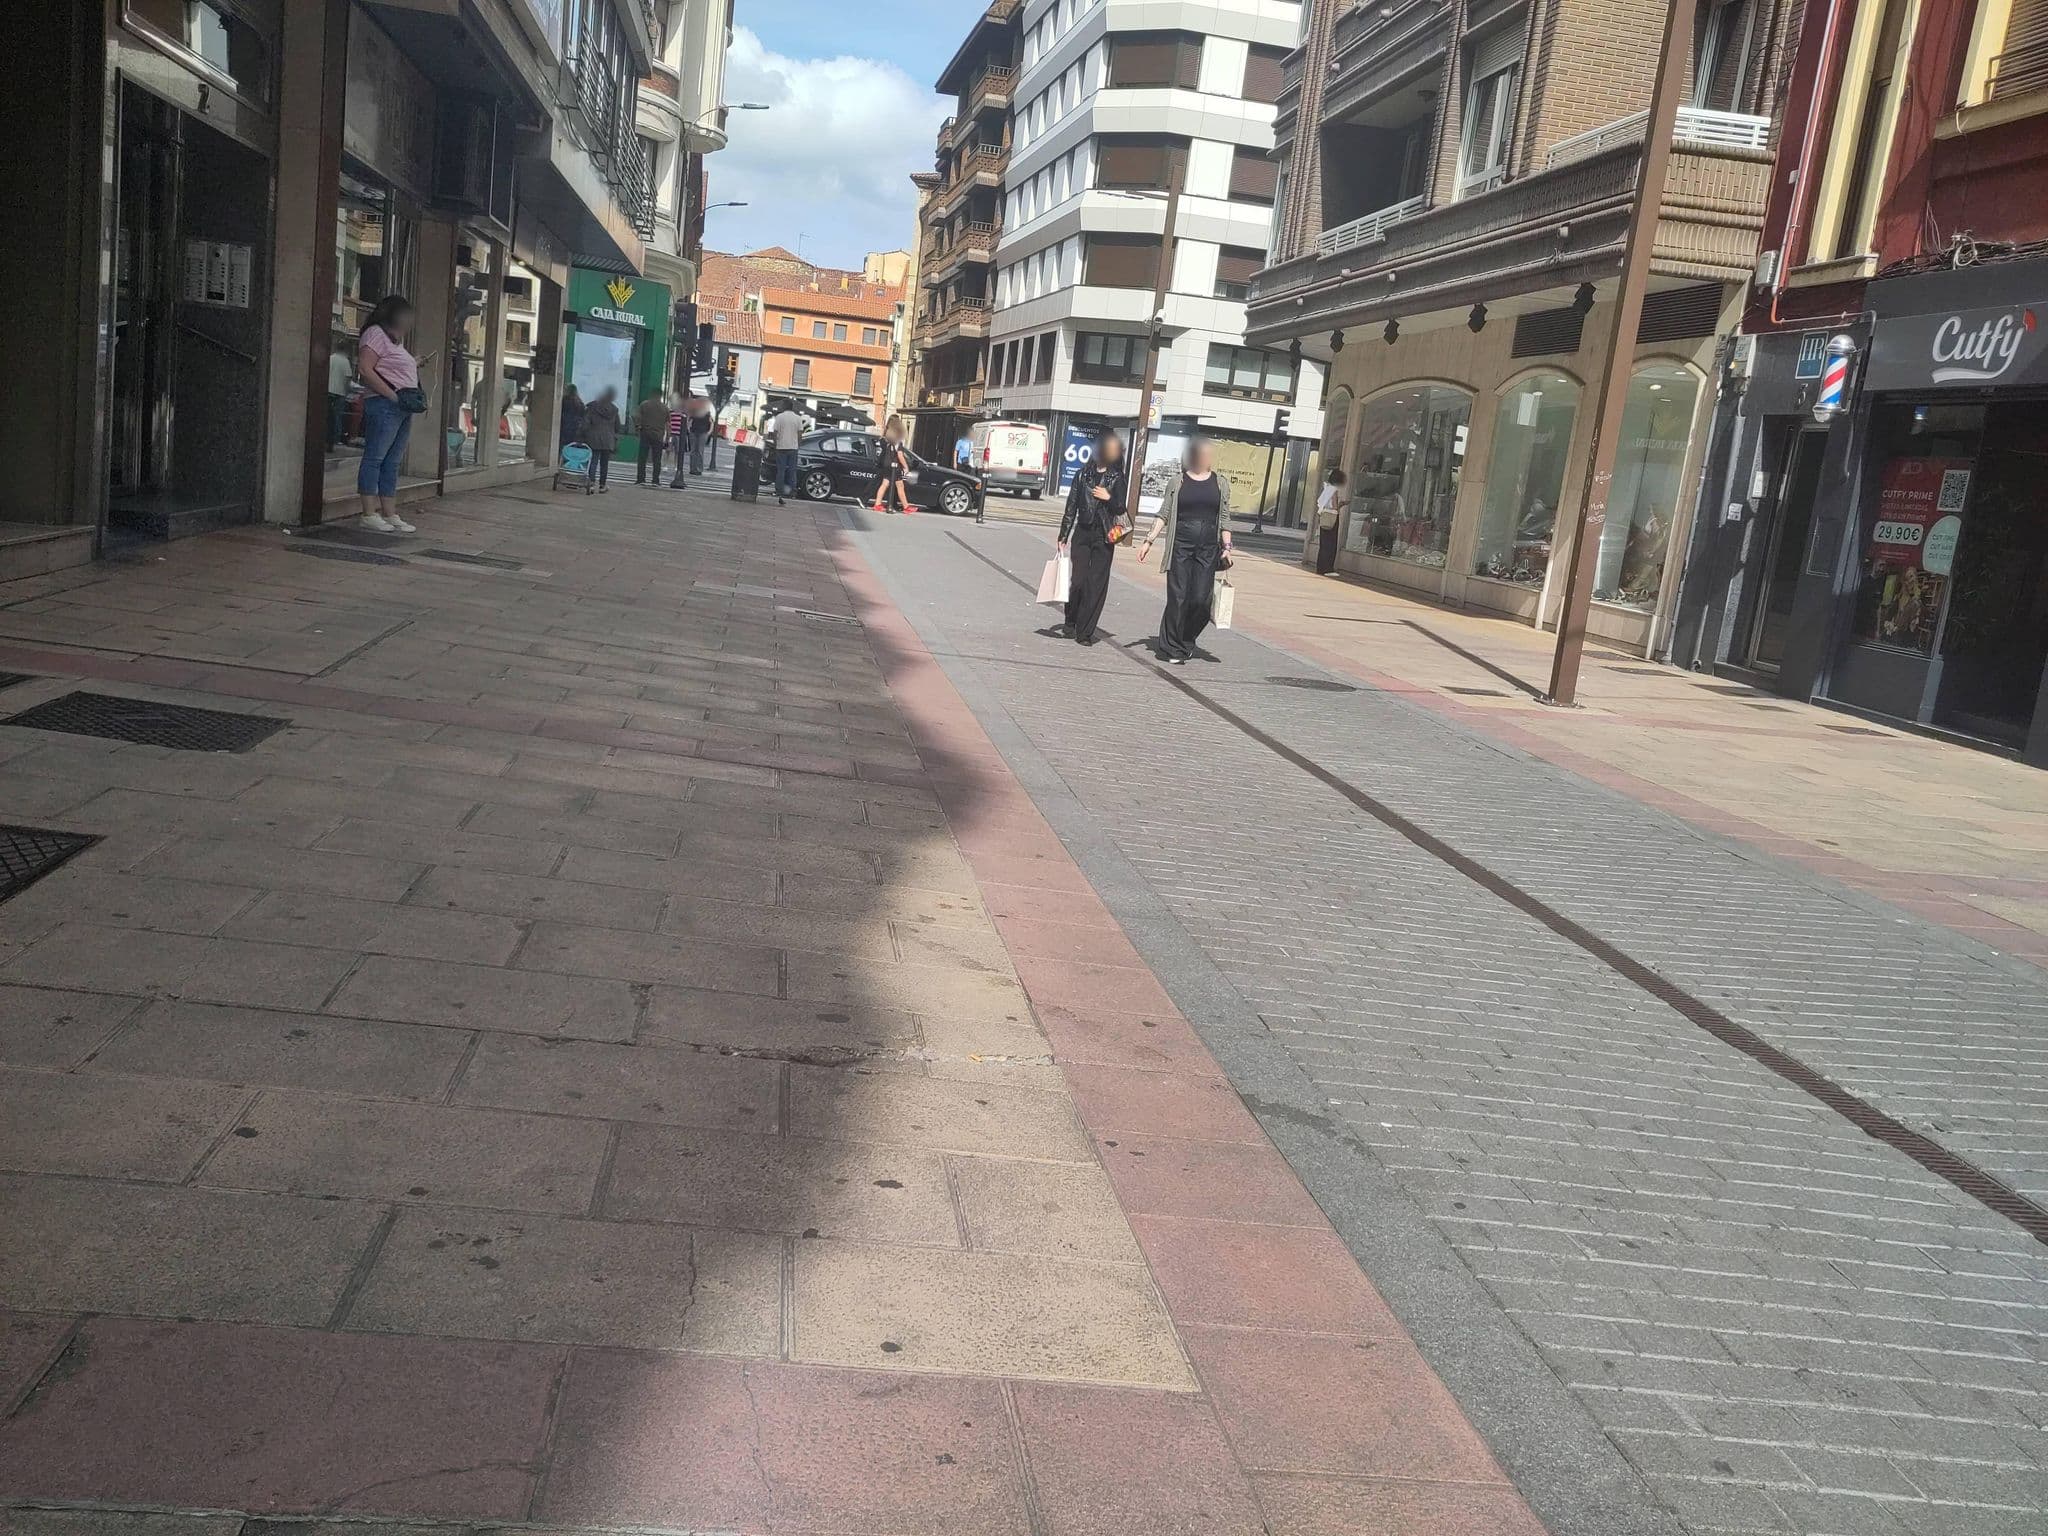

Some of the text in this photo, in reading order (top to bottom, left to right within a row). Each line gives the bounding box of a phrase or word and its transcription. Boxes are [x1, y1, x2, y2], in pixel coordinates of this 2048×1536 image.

[591, 306, 646, 326] CAJA RURAL
[1931, 314, 2025, 383] Cutfy
[1064, 443, 1092, 464] 60
[1882, 489, 1934, 501] CUTFY PRIME
[1878, 525, 1920, 541] 29,90€
